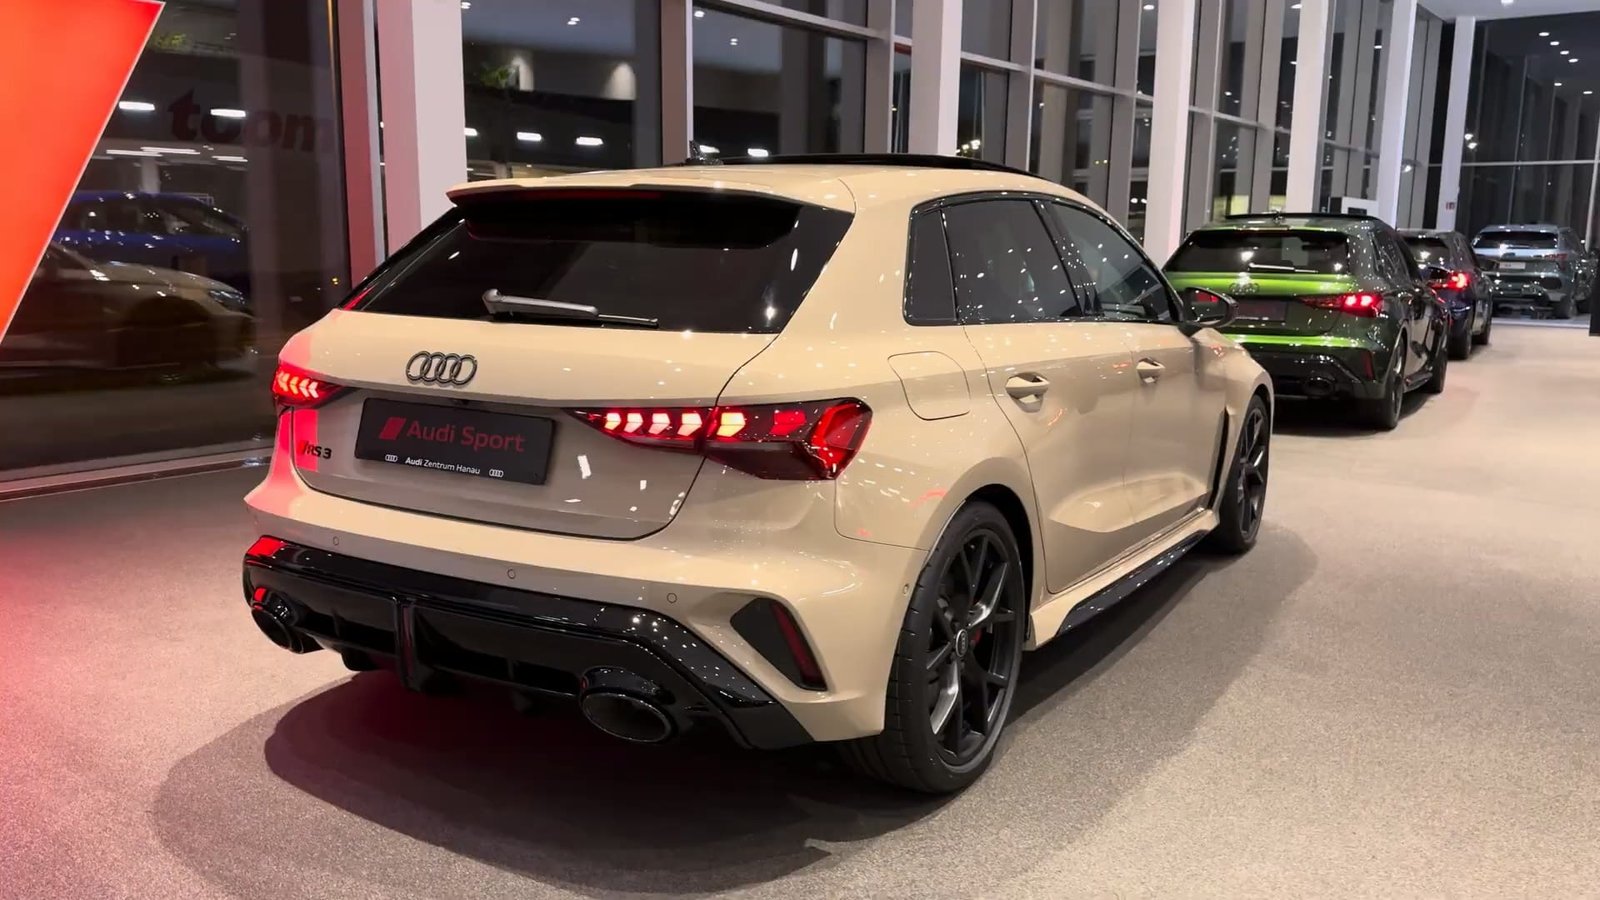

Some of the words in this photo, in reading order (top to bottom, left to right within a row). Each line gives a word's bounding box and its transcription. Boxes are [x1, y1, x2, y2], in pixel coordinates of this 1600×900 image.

[406, 420, 456, 443] Audi
[460, 426, 526, 453] Sport
[405, 456, 423, 466] Audi
[423, 459, 455, 471] Zentrum
[456, 464, 481, 475] Hanau
